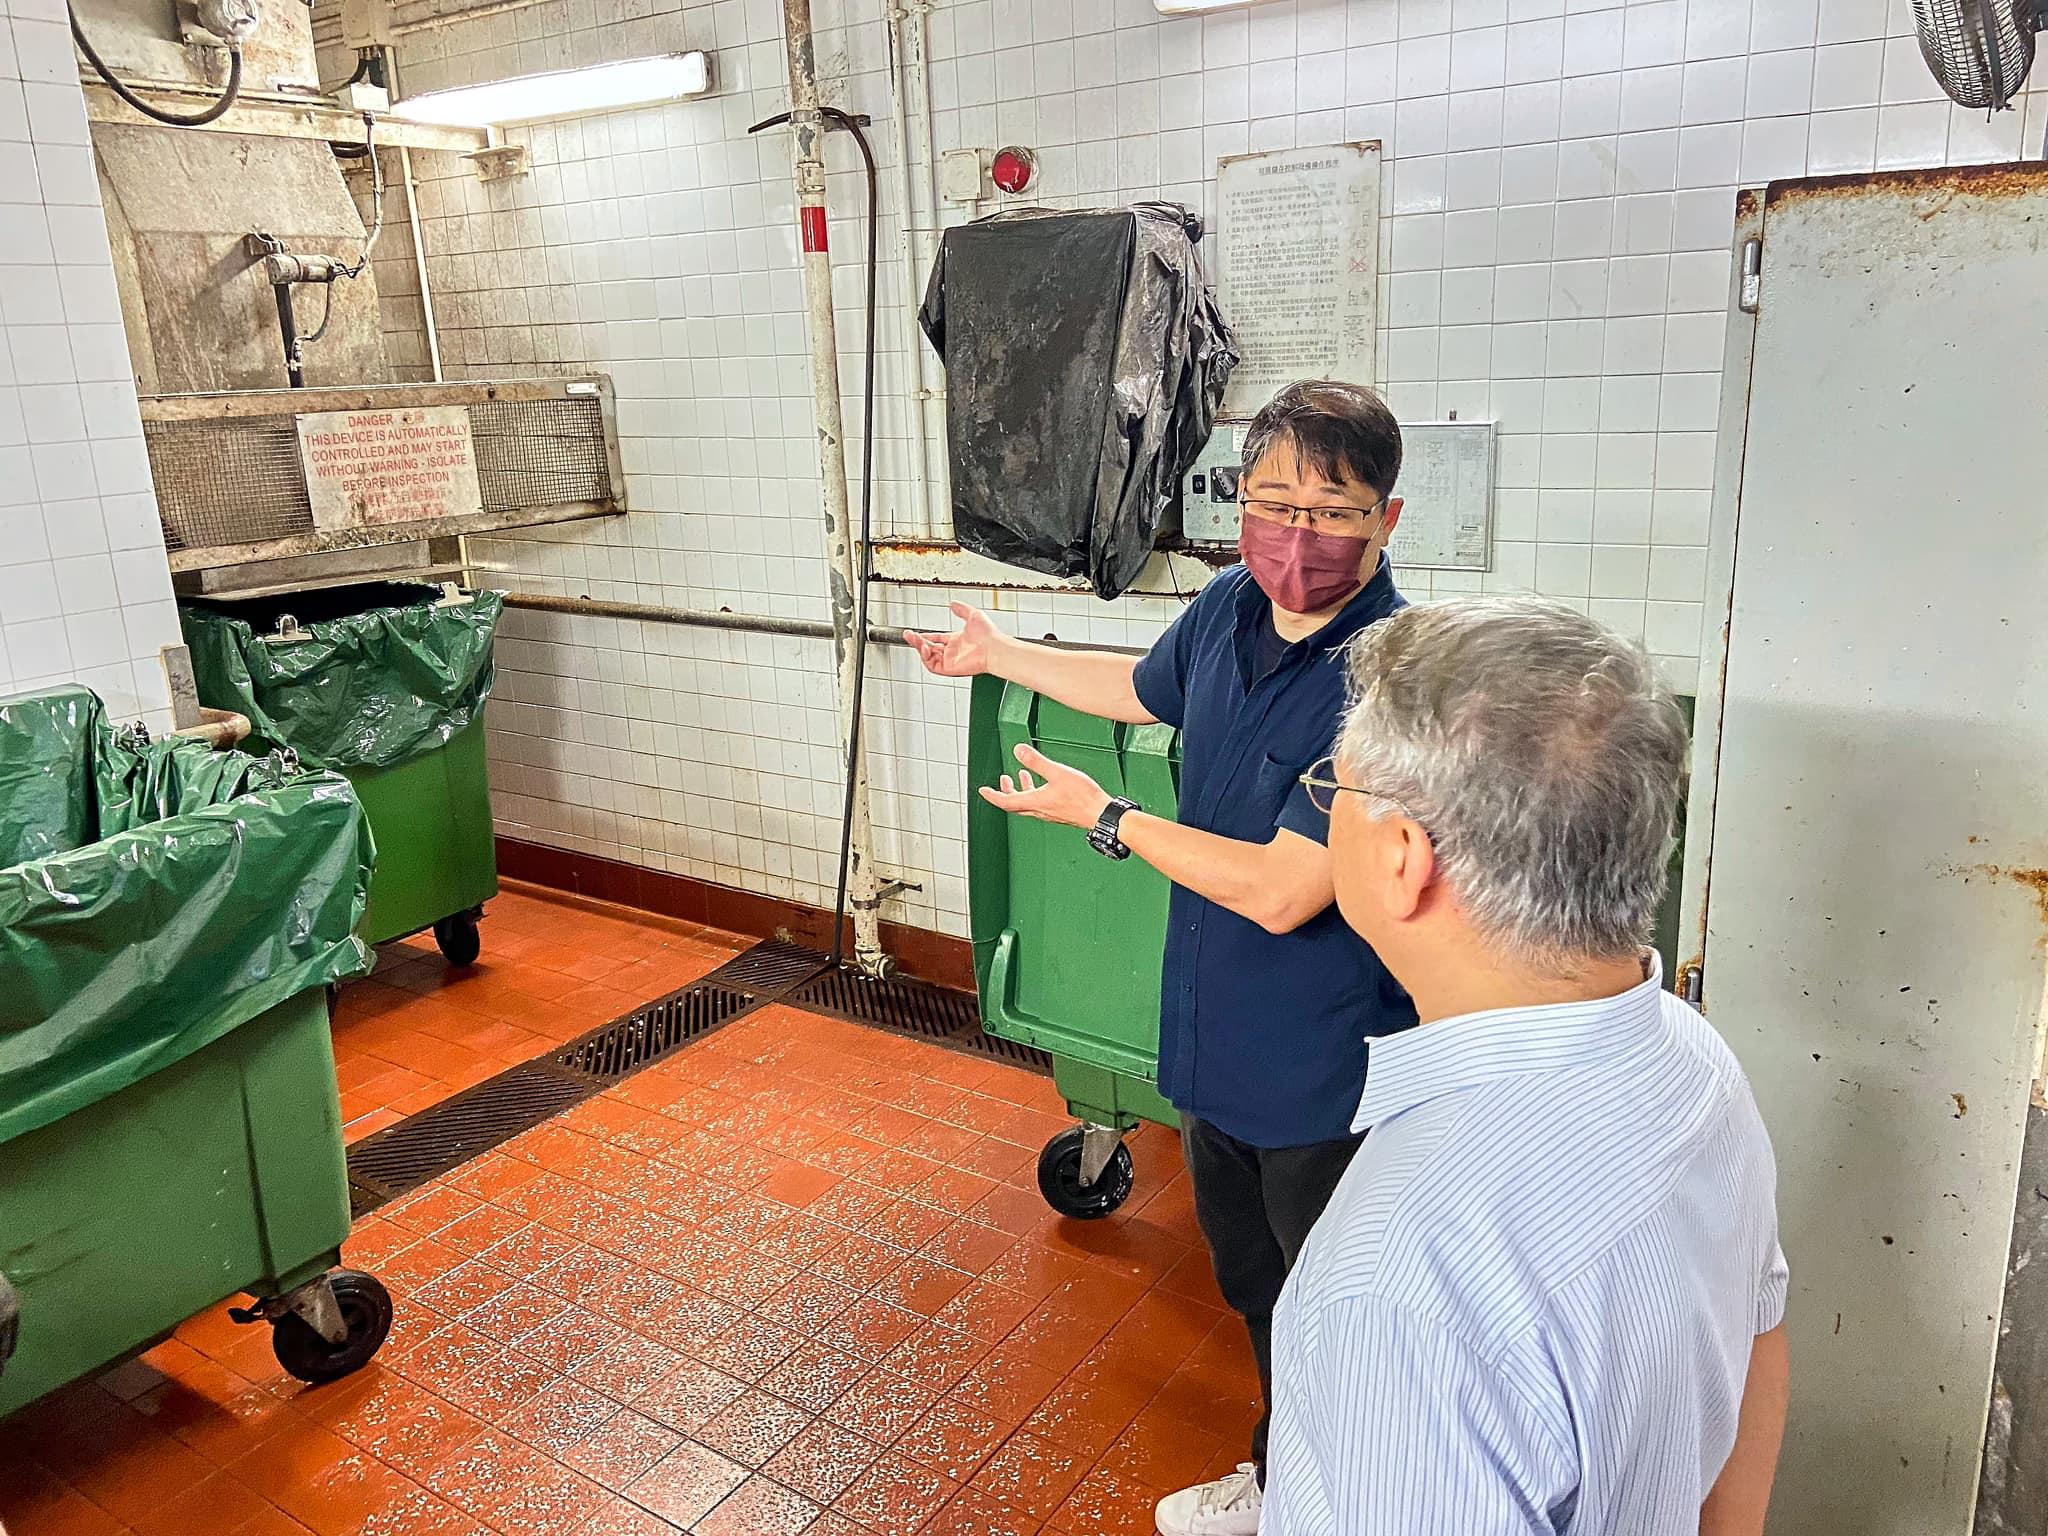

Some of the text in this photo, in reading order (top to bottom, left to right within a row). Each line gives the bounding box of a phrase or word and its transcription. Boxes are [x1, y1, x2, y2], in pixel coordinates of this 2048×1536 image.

[348, 414, 394, 428] DANGER
[304, 424, 468, 447] THIS DEVICE IS AUTOMATICALLY
[312, 439, 467, 463] CONTROLLED AND MAY START
[316, 462, 367, 478] WITHOUT
[370, 458, 419, 473] WARNING
[427, 453, 468, 468] ISOLATE
[343, 471, 450, 492] BEFORE INSPECTION
